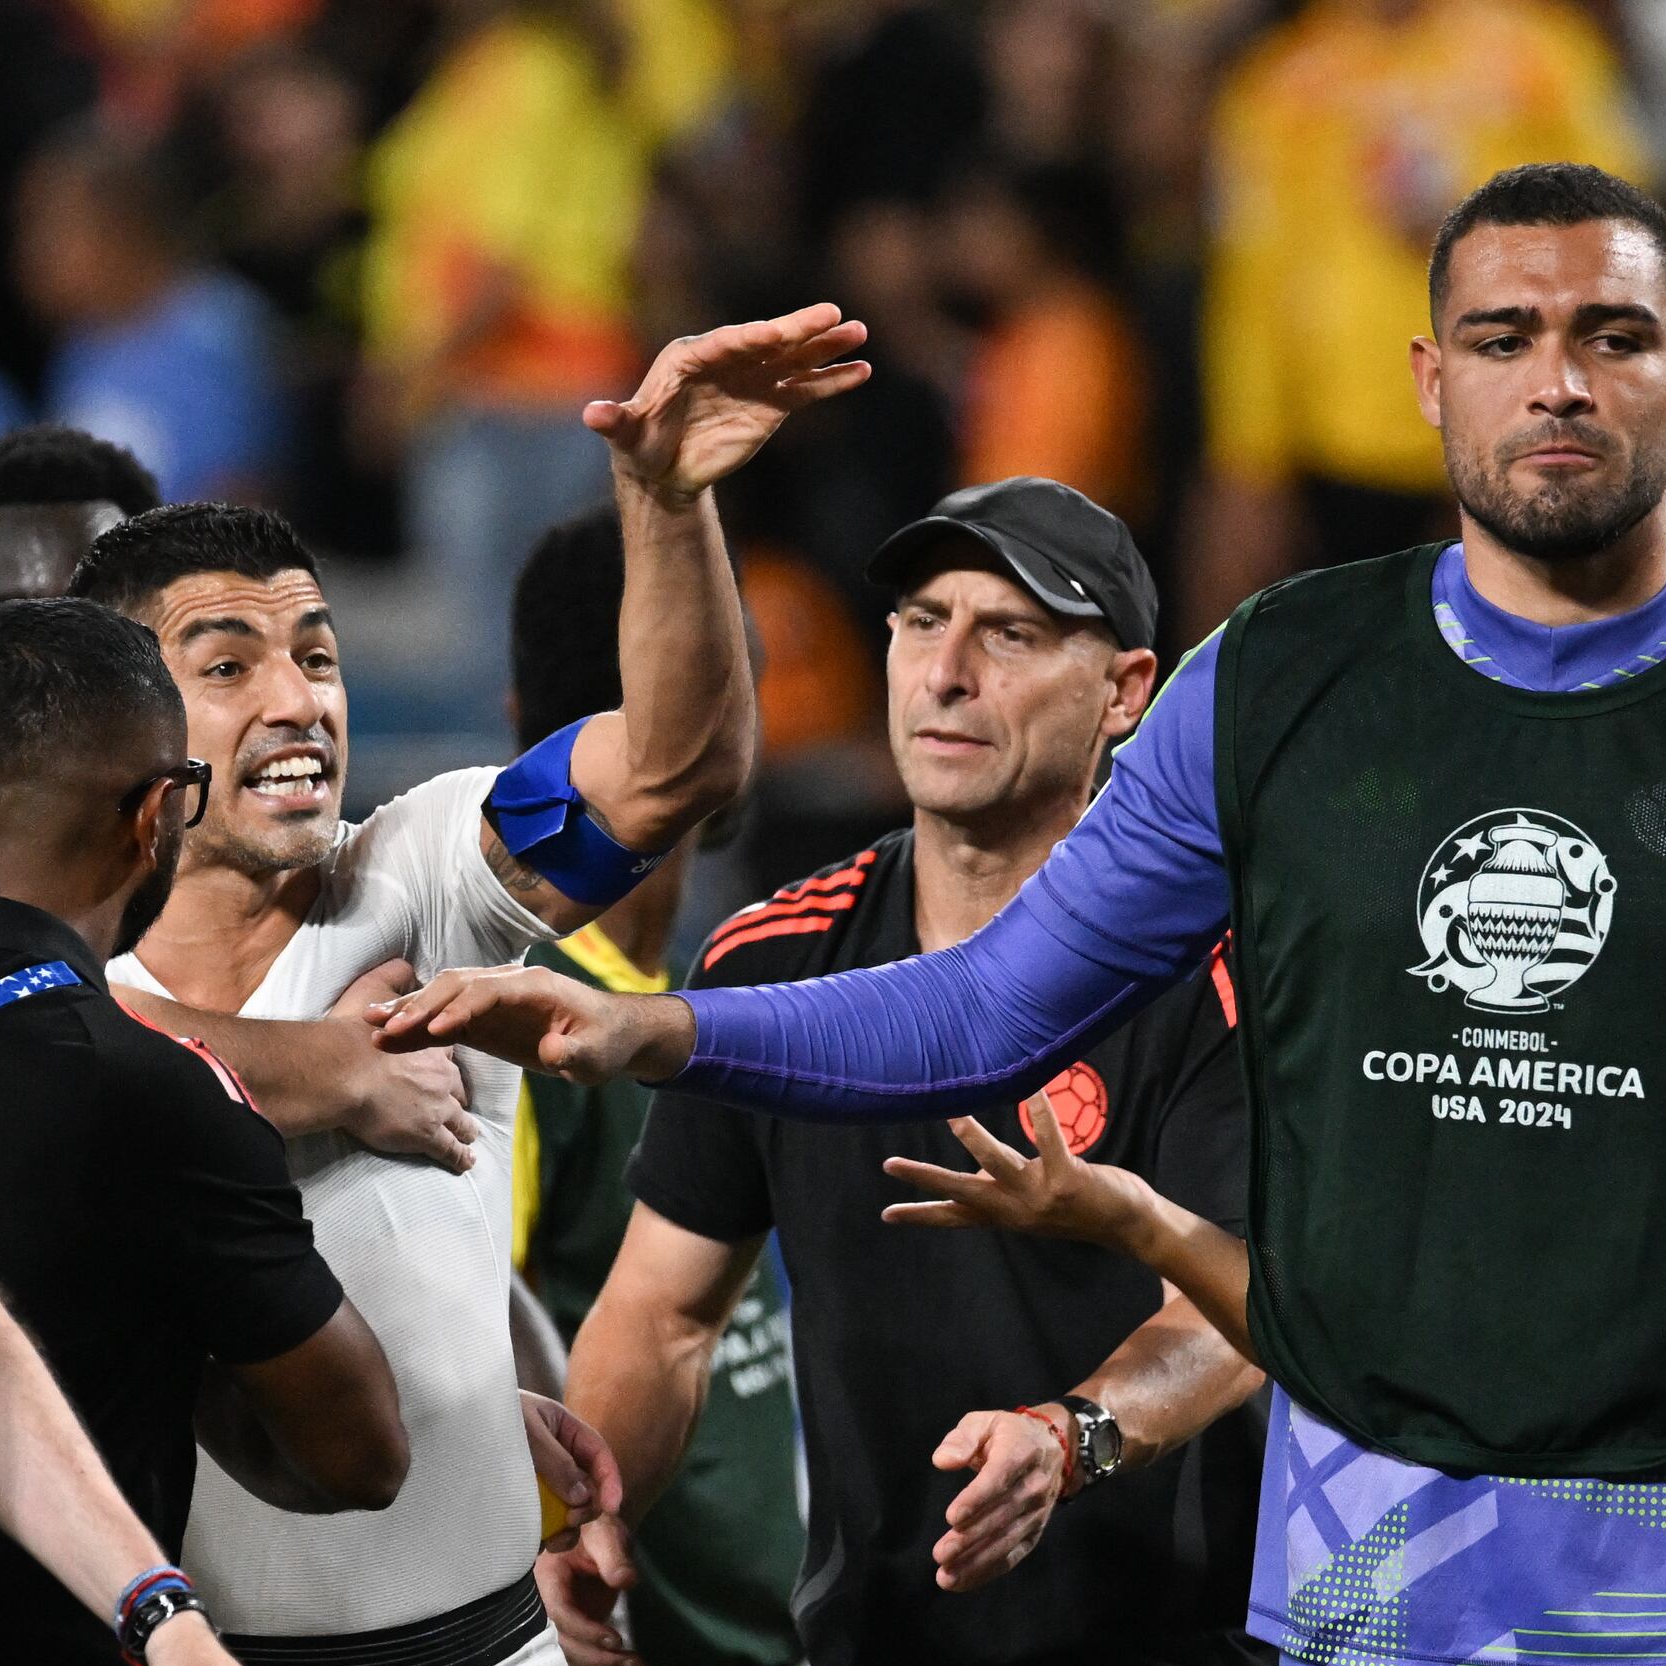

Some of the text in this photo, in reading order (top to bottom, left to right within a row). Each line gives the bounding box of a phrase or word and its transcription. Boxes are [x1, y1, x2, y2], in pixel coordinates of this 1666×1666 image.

[1362, 1050, 1645, 1099] COPA AMERICA
[1431, 1094, 1572, 1130] USA 2024
